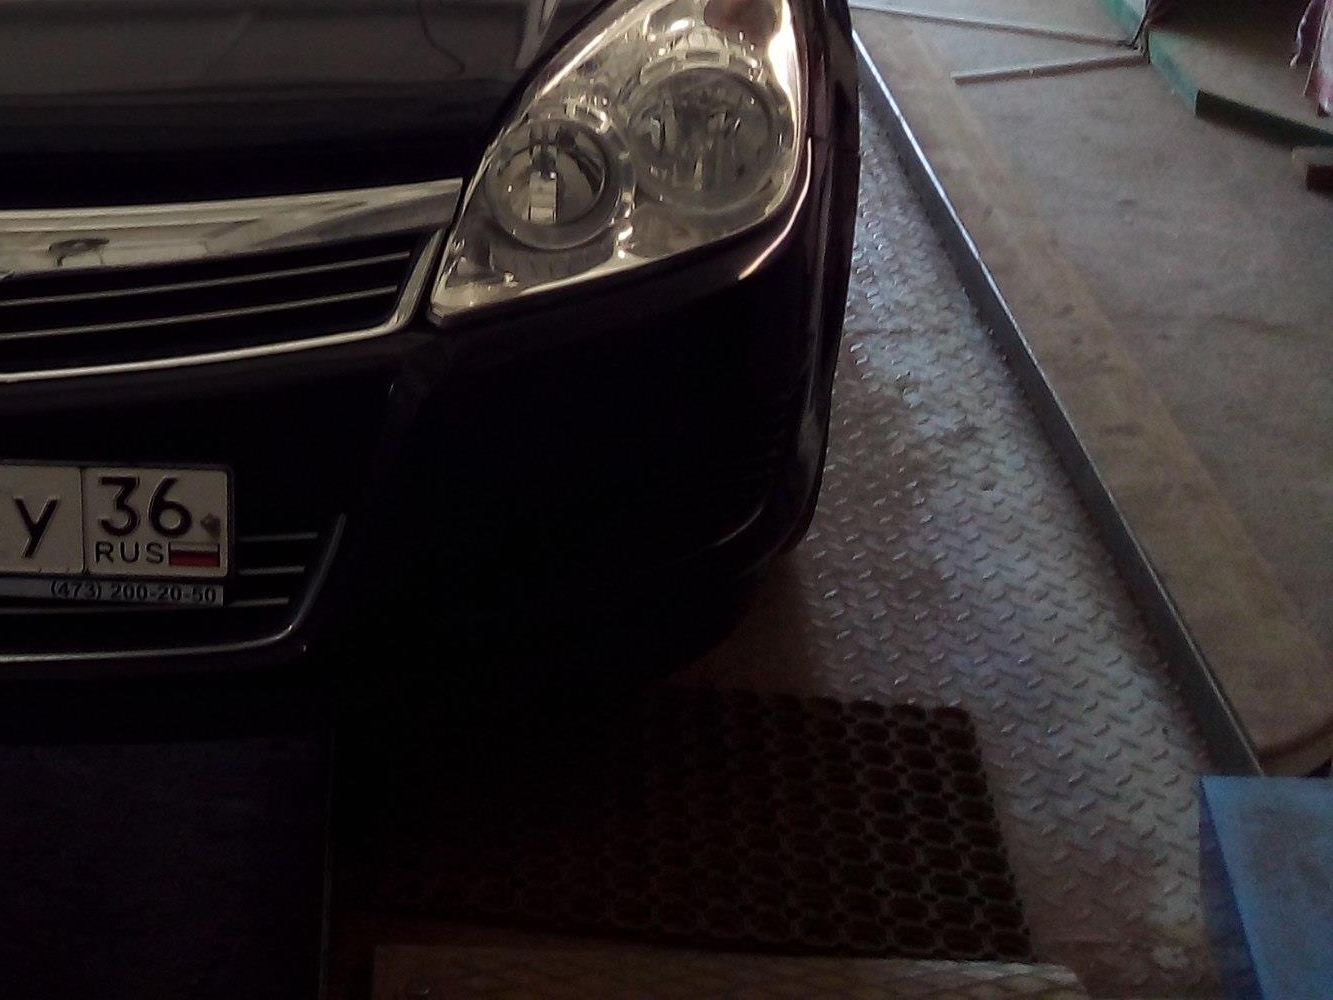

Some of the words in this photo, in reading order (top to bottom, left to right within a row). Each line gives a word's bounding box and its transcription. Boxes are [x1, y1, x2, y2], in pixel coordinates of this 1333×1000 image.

[98, 476, 193, 538] 36
[95, 540, 165, 564] RUS
[49, 578, 102, 600] (473)
[111, 582, 217, 604] 200-20-50
